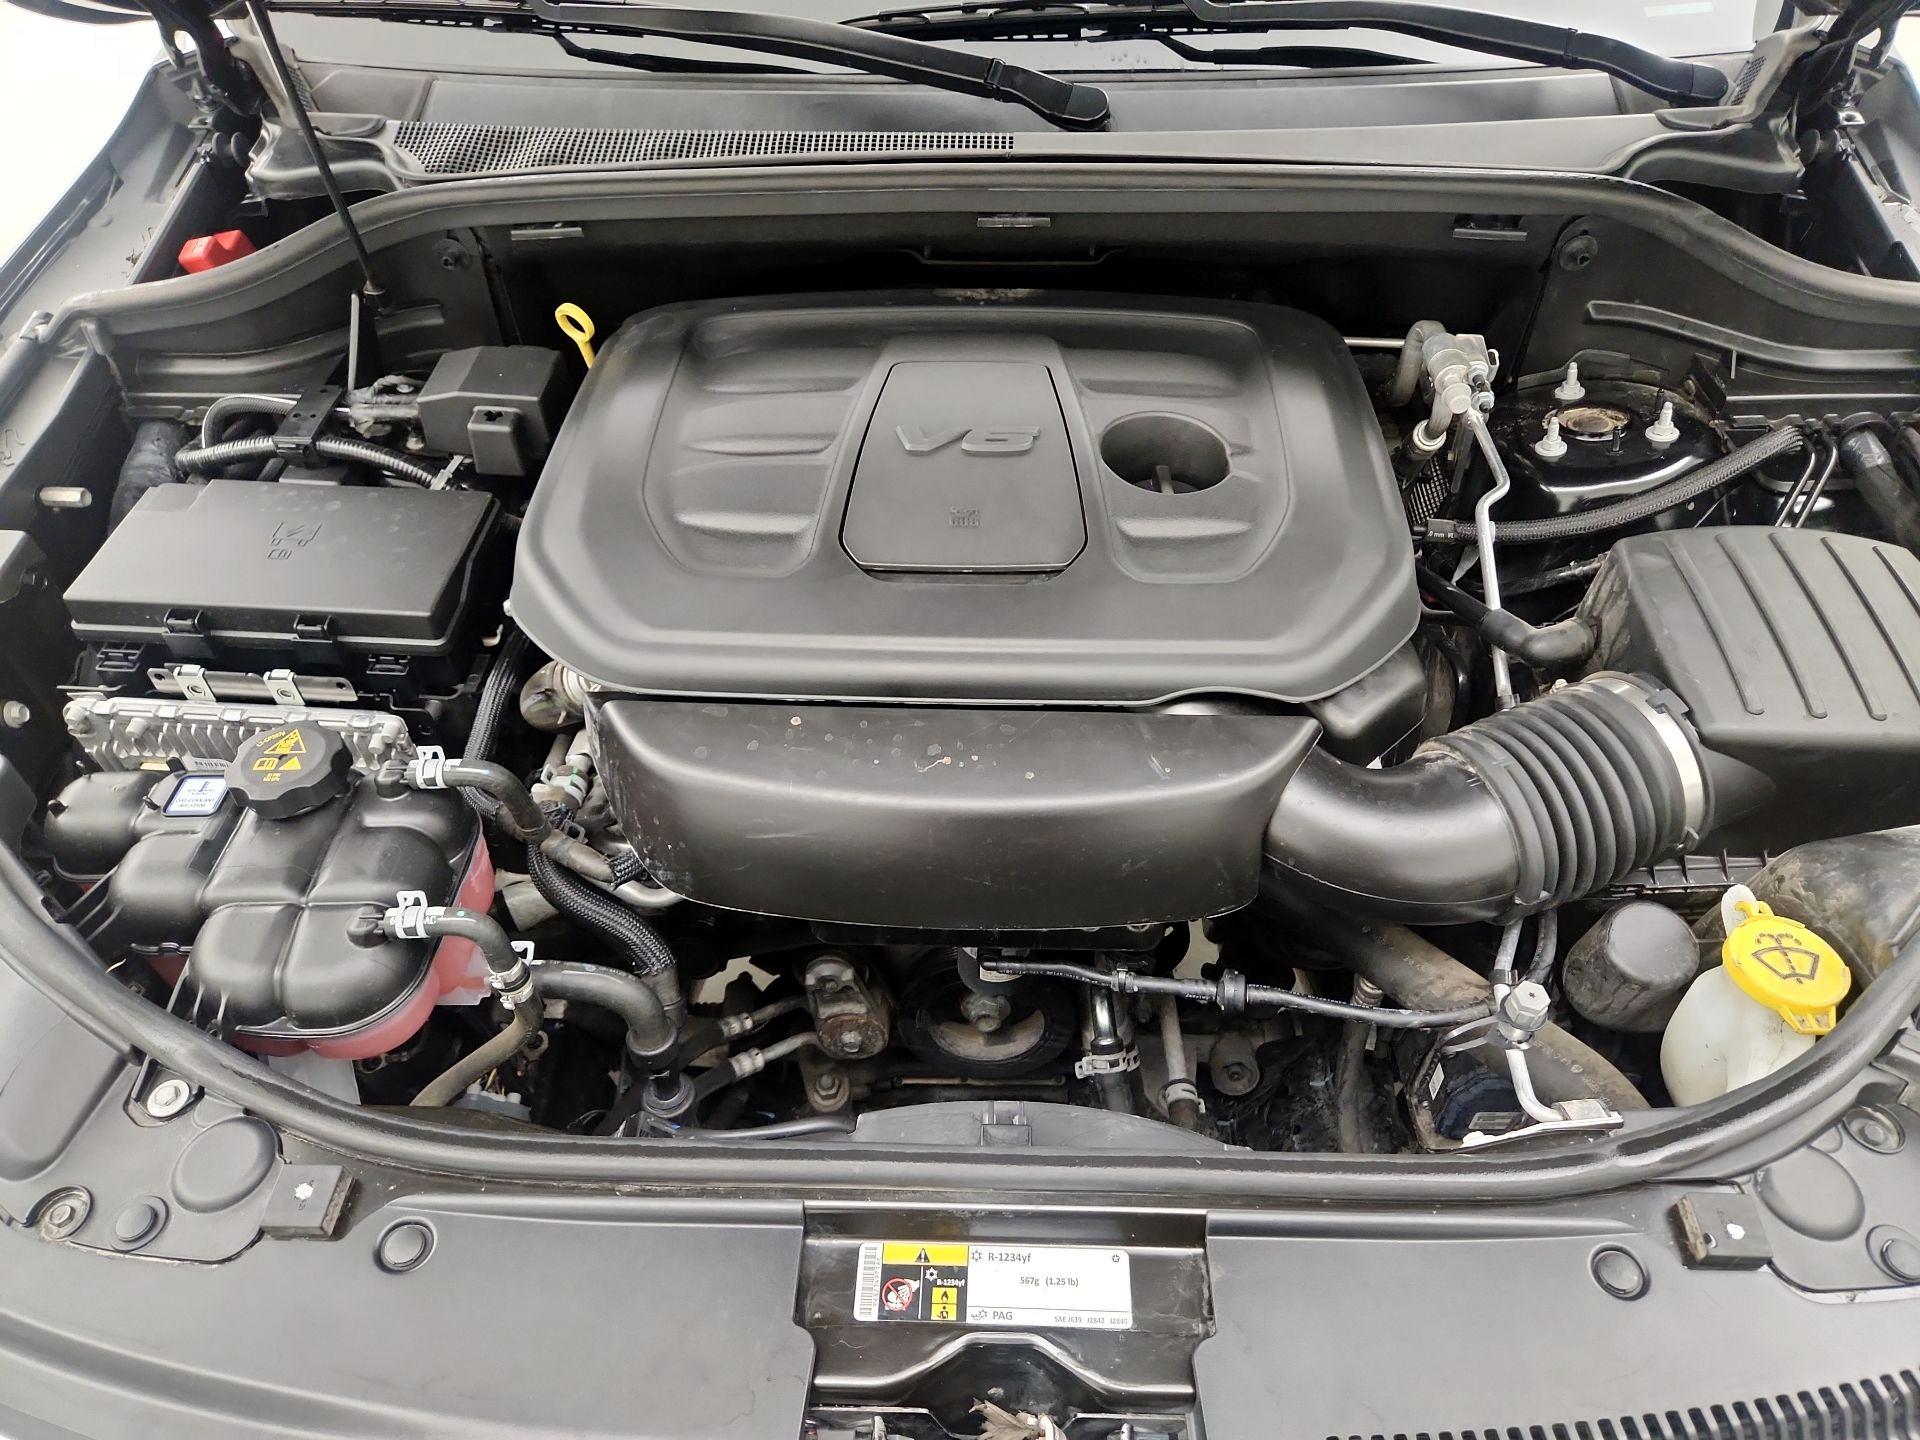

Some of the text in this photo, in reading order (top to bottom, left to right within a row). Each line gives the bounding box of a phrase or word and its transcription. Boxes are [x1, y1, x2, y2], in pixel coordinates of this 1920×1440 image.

[895, 424, 1041, 457] V6
[988, 1252, 1032, 1264] R-1234yf
[936, 1278, 966, 1288] R-1234yf
[1019, 1276, 1079, 1288] 567g (1.25 lb)
[992, 1311, 1013, 1321] PAG
